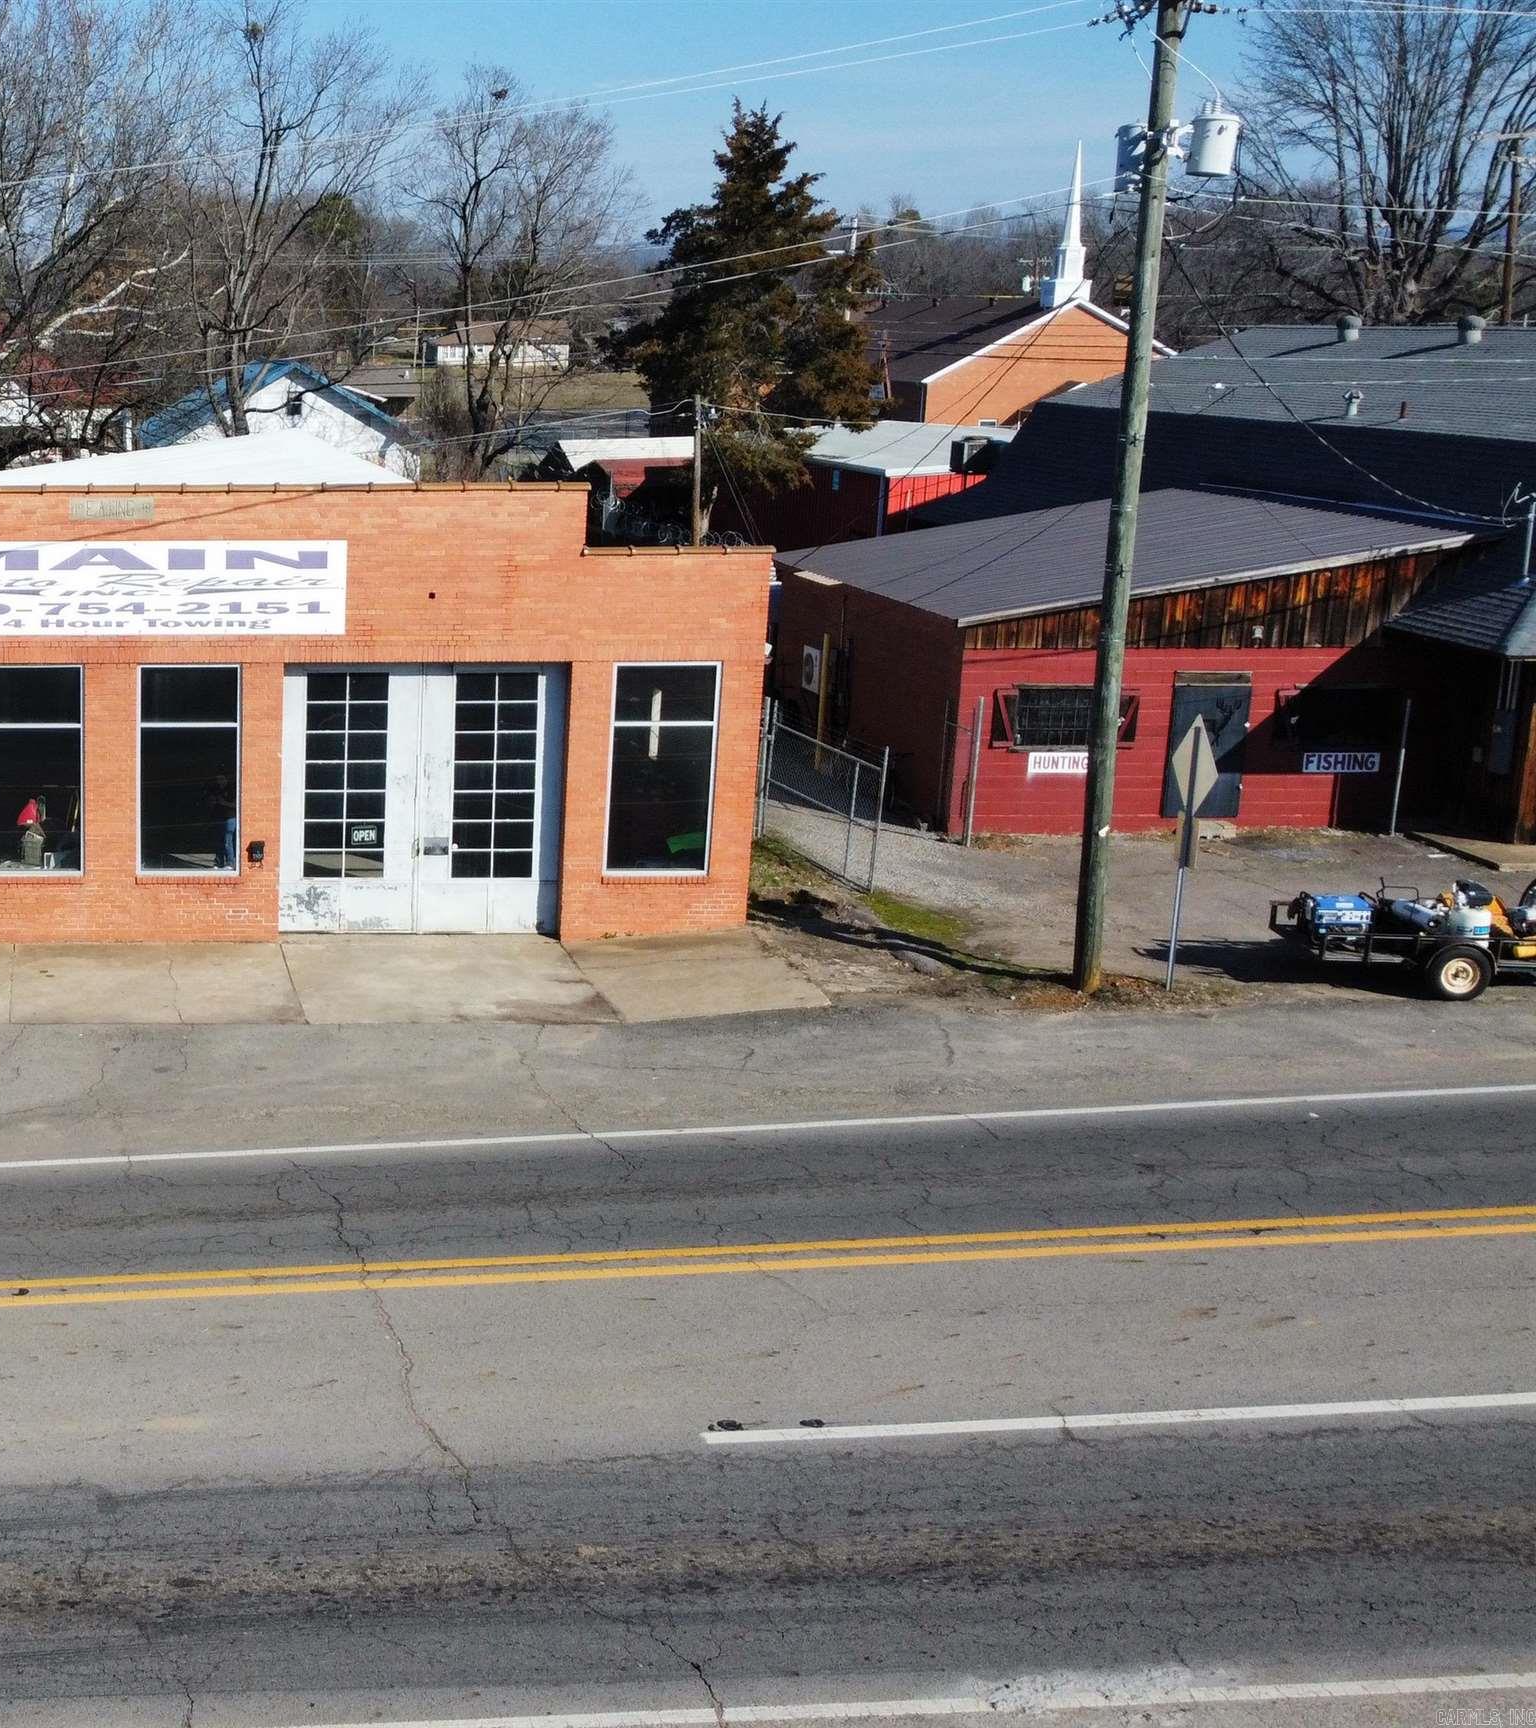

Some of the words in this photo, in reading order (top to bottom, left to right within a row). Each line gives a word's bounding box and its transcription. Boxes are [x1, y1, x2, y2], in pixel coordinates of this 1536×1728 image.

[96, 573, 330, 591] Repair
[40, 618, 130, 628] Hour
[143, 618, 272, 630] Towing
[1032, 756, 1088, 770] HUNTING
[1305, 753, 1376, 771] FISHING
[353, 829, 375, 841] OPEN
